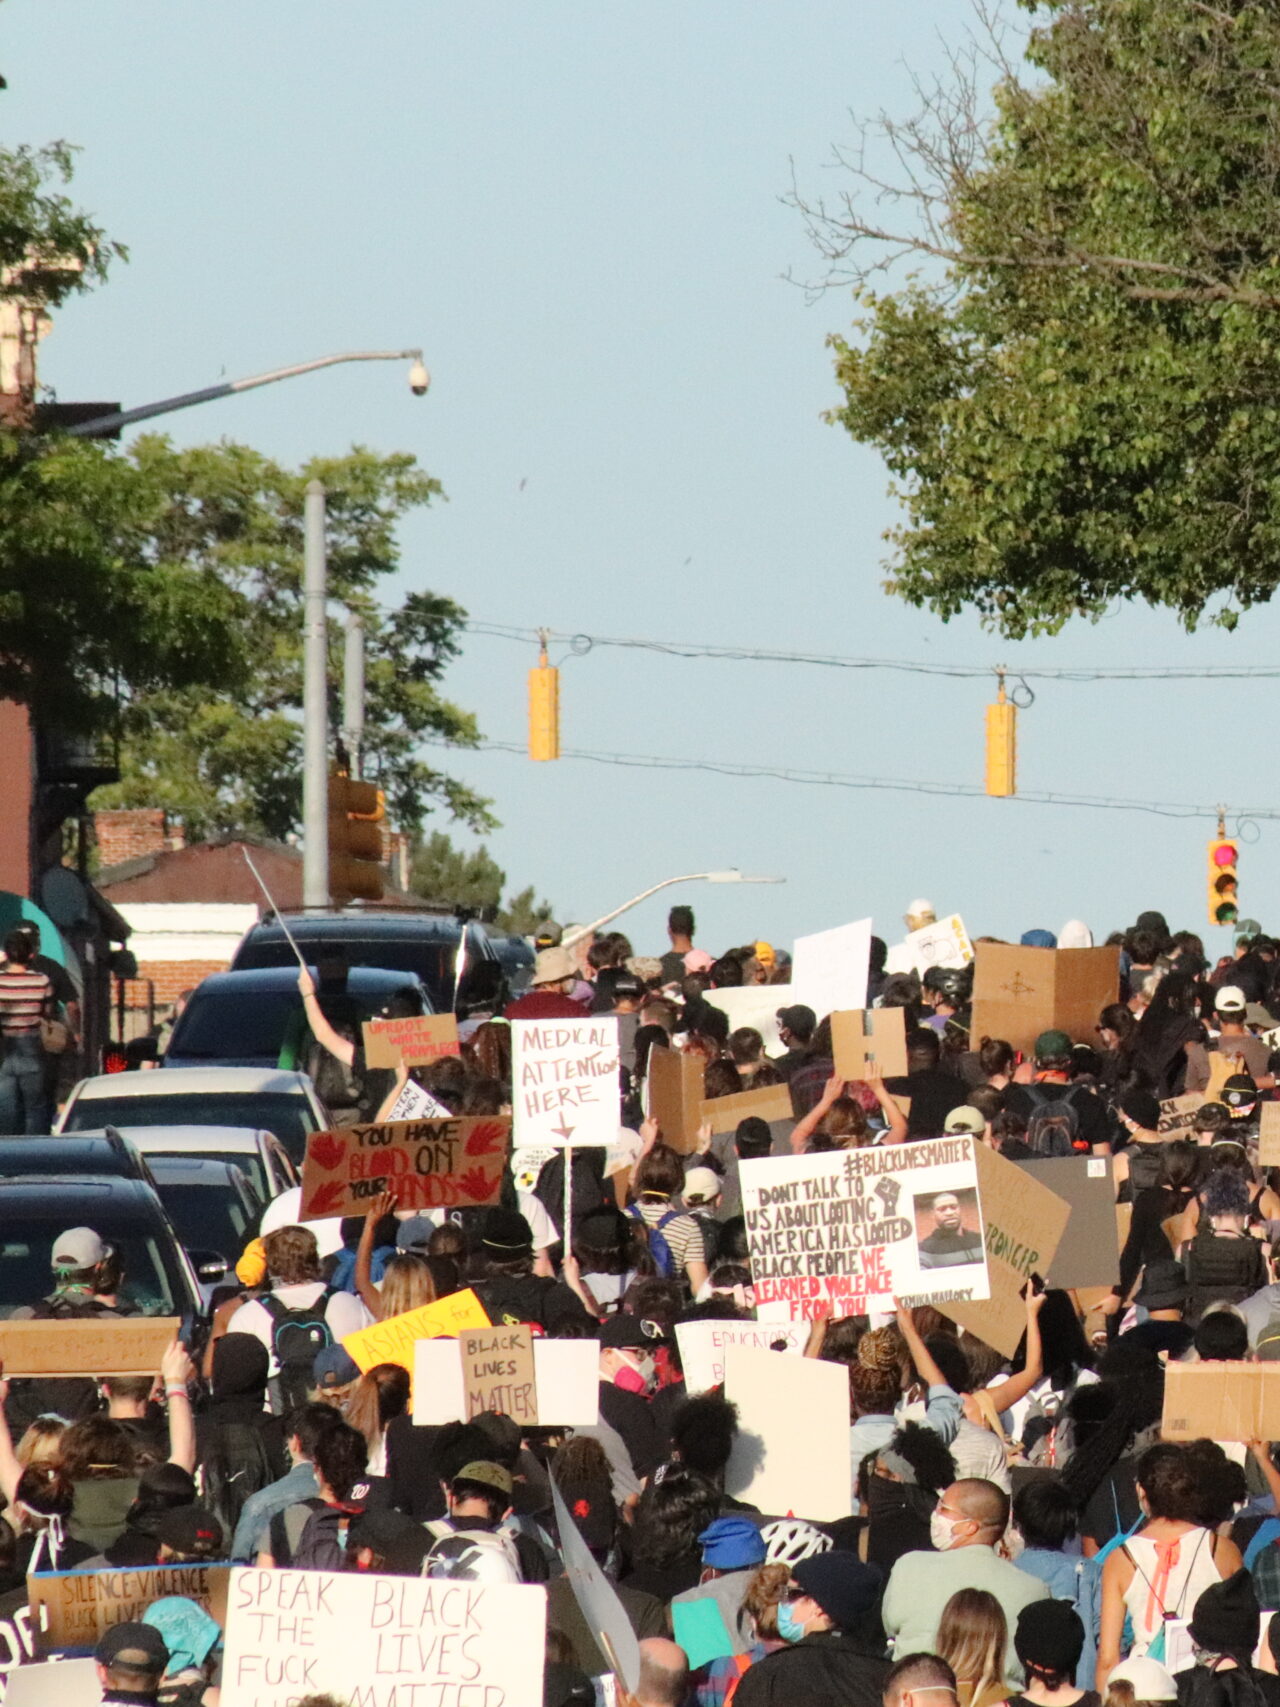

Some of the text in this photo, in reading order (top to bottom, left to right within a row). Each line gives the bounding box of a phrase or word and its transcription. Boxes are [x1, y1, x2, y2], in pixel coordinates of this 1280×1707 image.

[522, 1026, 612, 1052] MEDICAL
[525, 1085, 600, 1118] HERE
[351, 1119, 463, 1147] YOU HAVE
[415, 1143, 454, 1176] ON
[348, 1176, 389, 1200] YOUR
[802, 1175, 841, 1200] TALK
[844, 1175, 864, 1197] TO
[746, 1196, 877, 1231] US ABOUT LOOTING
[750, 1217, 913, 1256] AMERICA HAS LOOTED
[984, 1221, 1040, 1279] TRONGER
[752, 1246, 887, 1281] BLACK PEOPLE WE
[753, 1269, 893, 1306] LEARNED VIOLENCE
[838, 1294, 868, 1318] YOU
[361, 1304, 475, 1363] ASIANS for
[466, 1334, 526, 1356] BLACK
[473, 1360, 518, 1379] LIVES
[469, 1382, 537, 1419] MATTER
[236, 1570, 335, 1616] SPEAK
[369, 1579, 487, 1631] BLACK
[246, 1612, 316, 1646] THE
[237, 1654, 319, 1689] FUCK
[375, 1632, 483, 1682] LIVES
